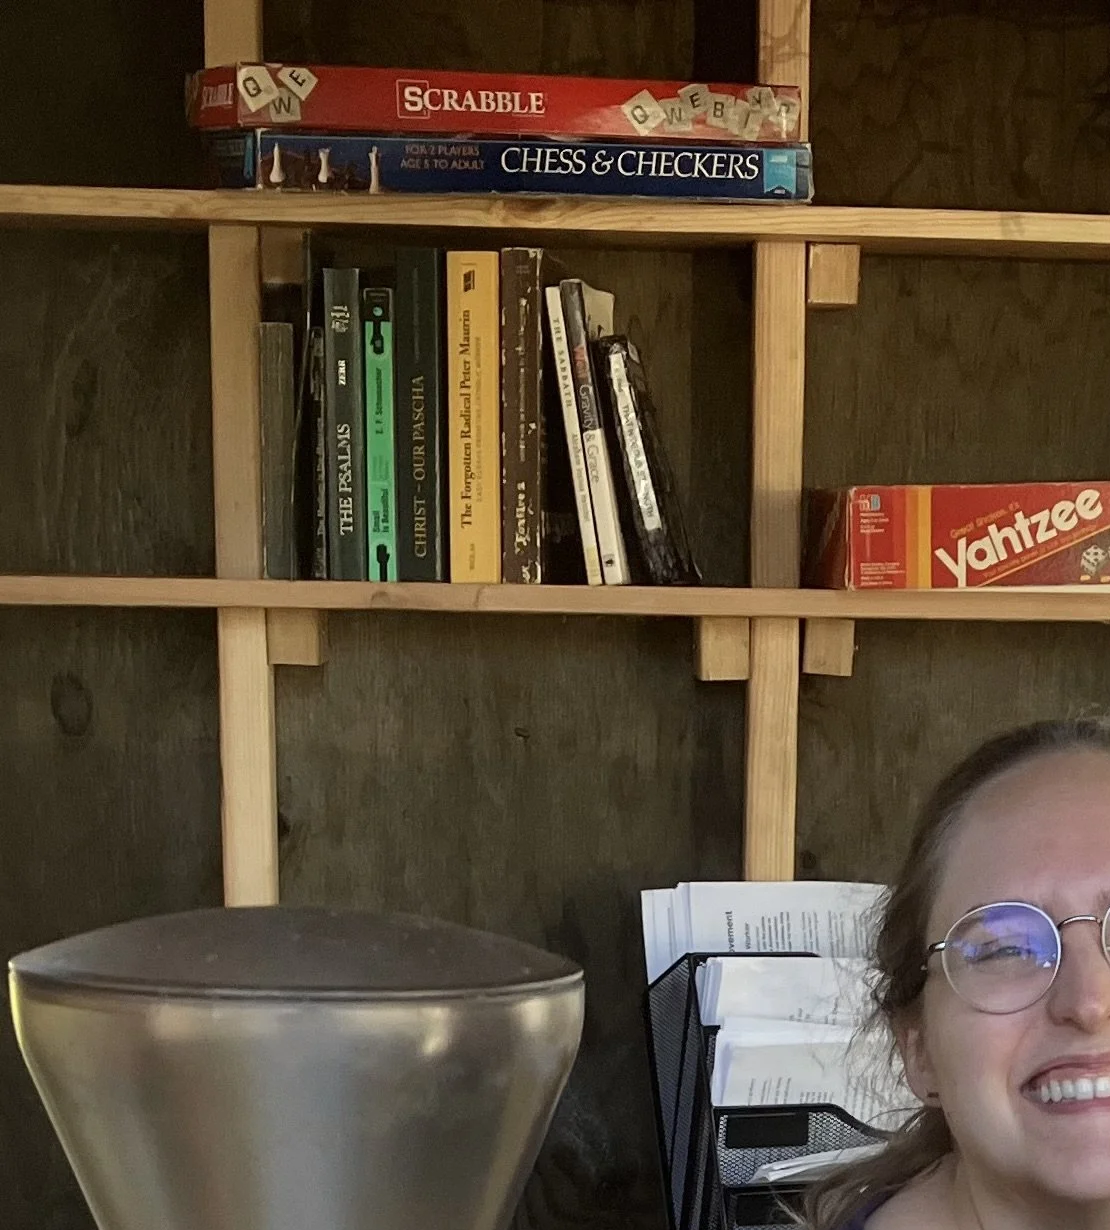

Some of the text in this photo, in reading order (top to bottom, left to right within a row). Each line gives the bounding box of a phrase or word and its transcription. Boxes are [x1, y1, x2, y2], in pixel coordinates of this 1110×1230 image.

[403, 86, 546, 115] SCRABBLE
[404, 144, 428, 155] FOR
[438, 145, 480, 157] PLAYERS
[433, 158, 449, 170] TO
[501, 147, 760, 180] CHESS & CHECKERS
[458, 309, 471, 356] Maurin
[337, 359, 347, 386] ZERR
[459, 358, 472, 390] Peter
[552, 317, 573, 408] THE SABBATH
[411, 375, 426, 442] PASCHA
[459, 393, 472, 438] Radical
[579, 384, 600, 484] Gravity & Grace
[335, 423, 354, 536] THE PSALMS
[413, 443, 426, 481] OUR
[459, 441, 475, 500] Forgotten
[413, 495, 428, 558] CHRIST
[460, 504, 473, 529] The
[934, 489, 1104, 588] Yahtzee
